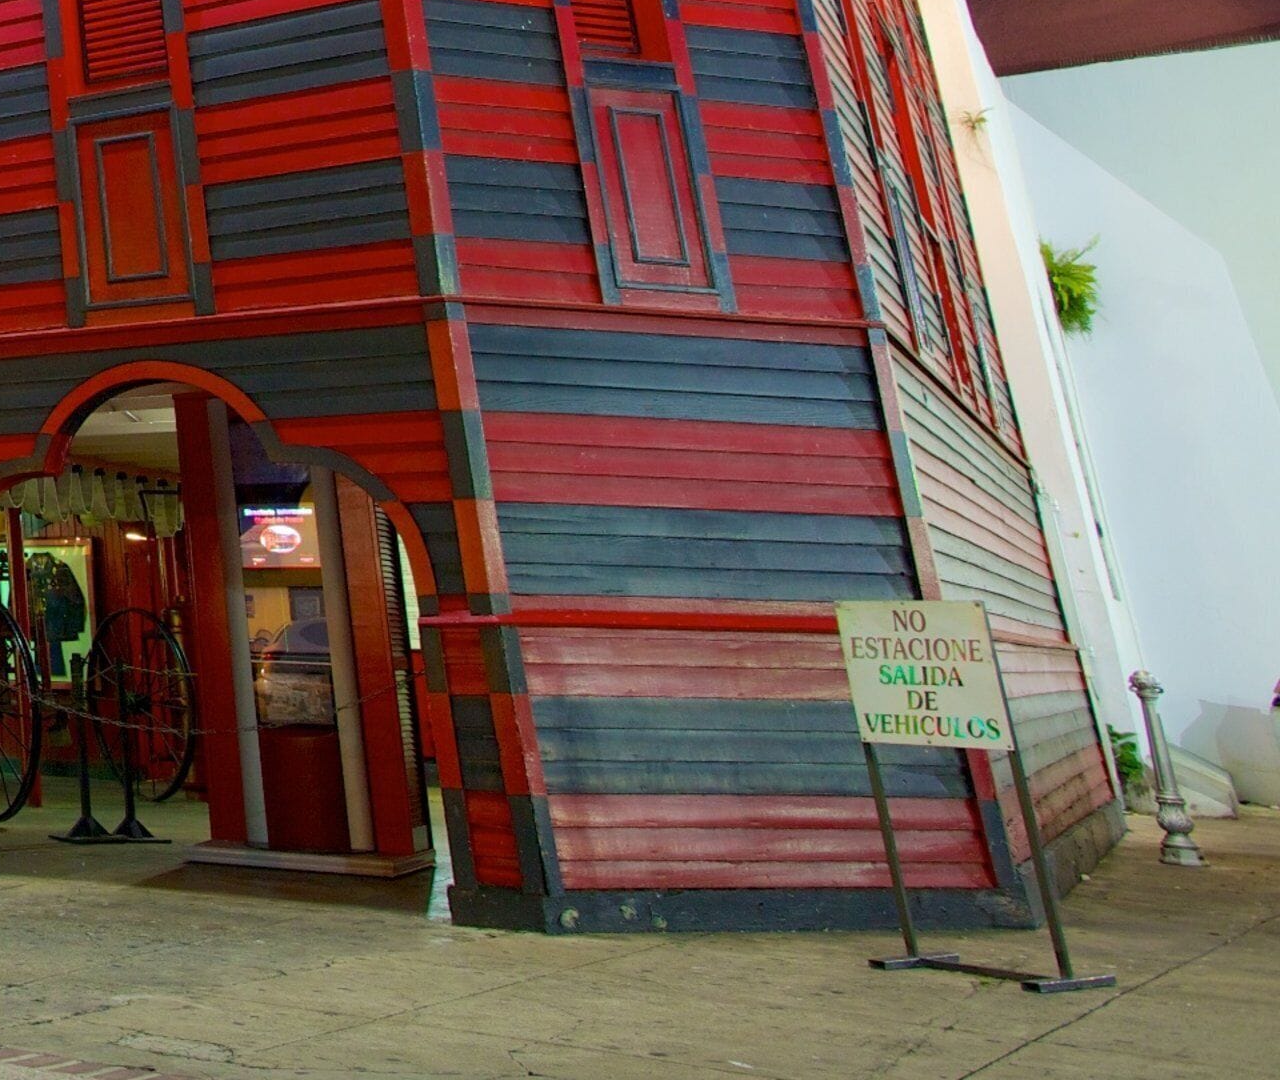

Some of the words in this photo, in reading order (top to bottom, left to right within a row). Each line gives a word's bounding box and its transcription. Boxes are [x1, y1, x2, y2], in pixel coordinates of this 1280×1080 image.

[892, 609, 927, 633] NO
[850, 636, 984, 663] ESTACIONE
[878, 664, 964, 687] SALIDA
[906, 690, 939, 712] DE
[864, 712, 1002, 740] VEHICULOS
